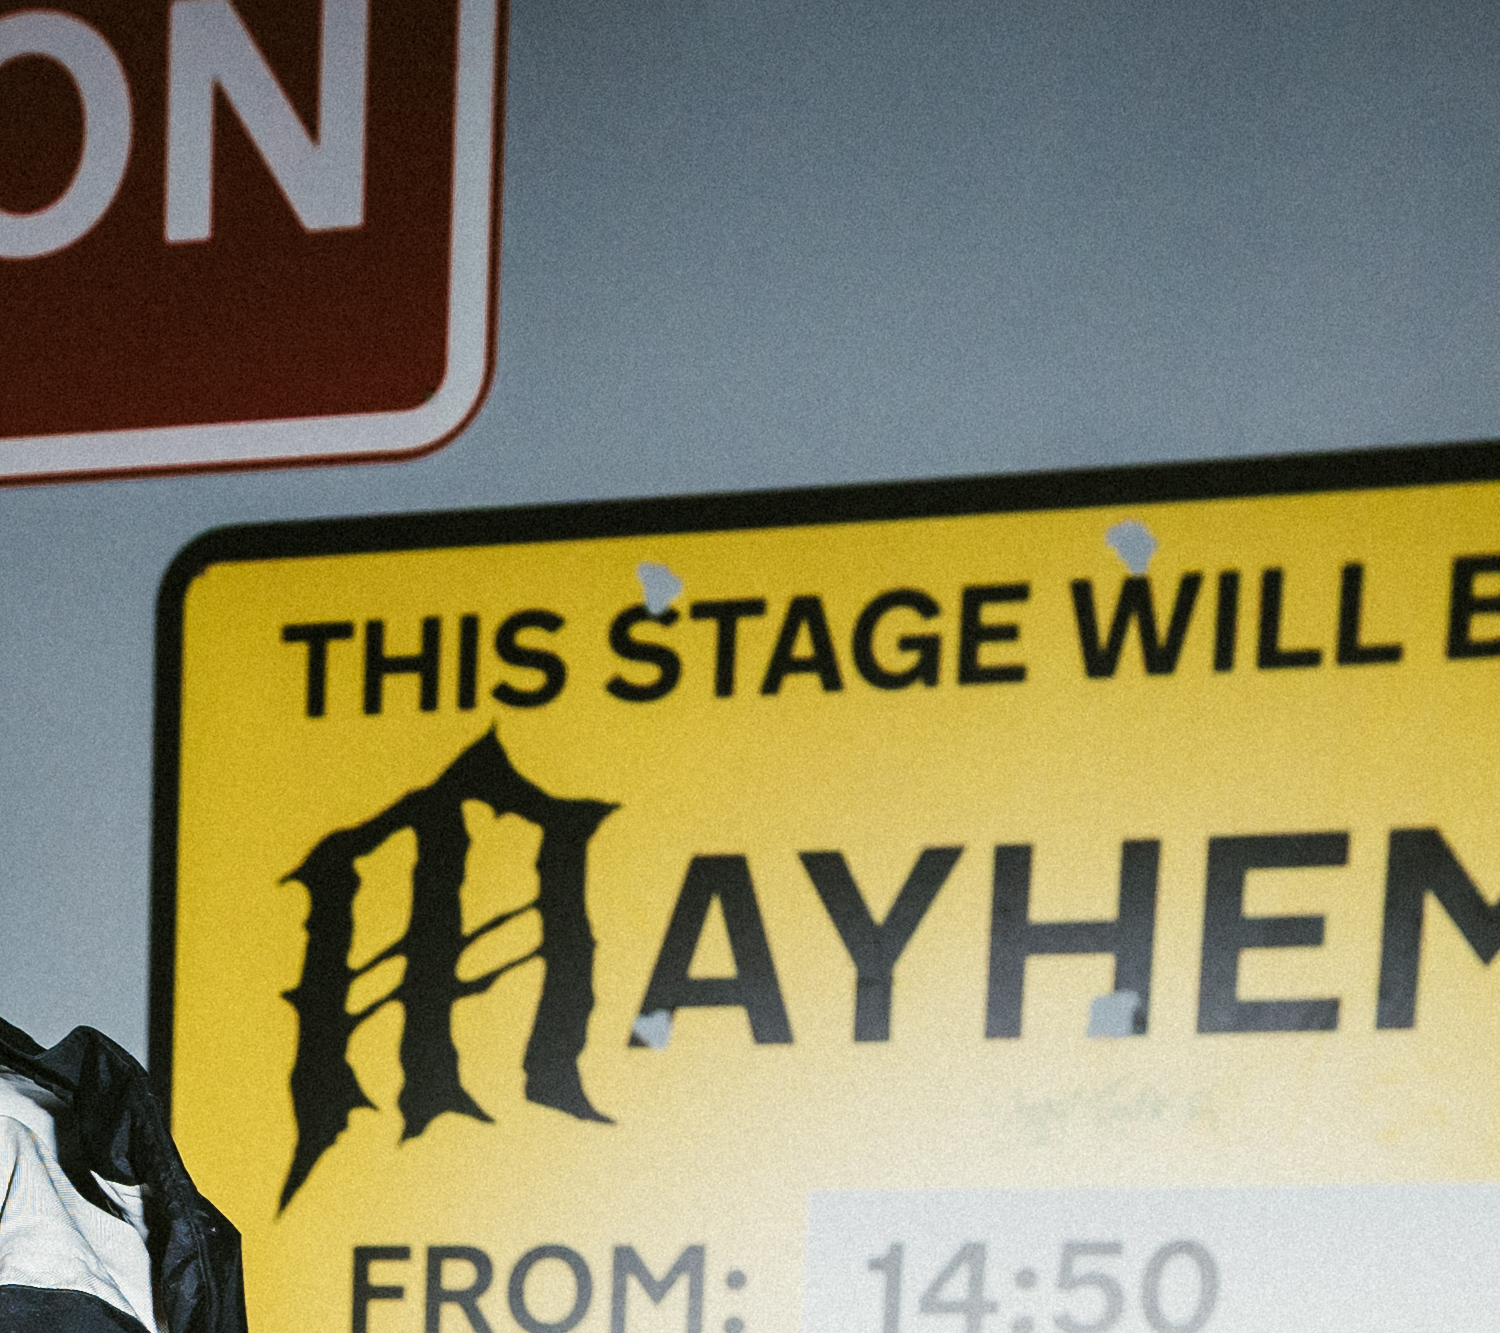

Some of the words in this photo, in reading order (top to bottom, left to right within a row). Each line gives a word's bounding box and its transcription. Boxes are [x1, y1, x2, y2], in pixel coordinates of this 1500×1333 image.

[280, 607, 571, 720] THIS
[603, 580, 1032, 705] STAGE
[1070, 559, 1405, 681] WILL
